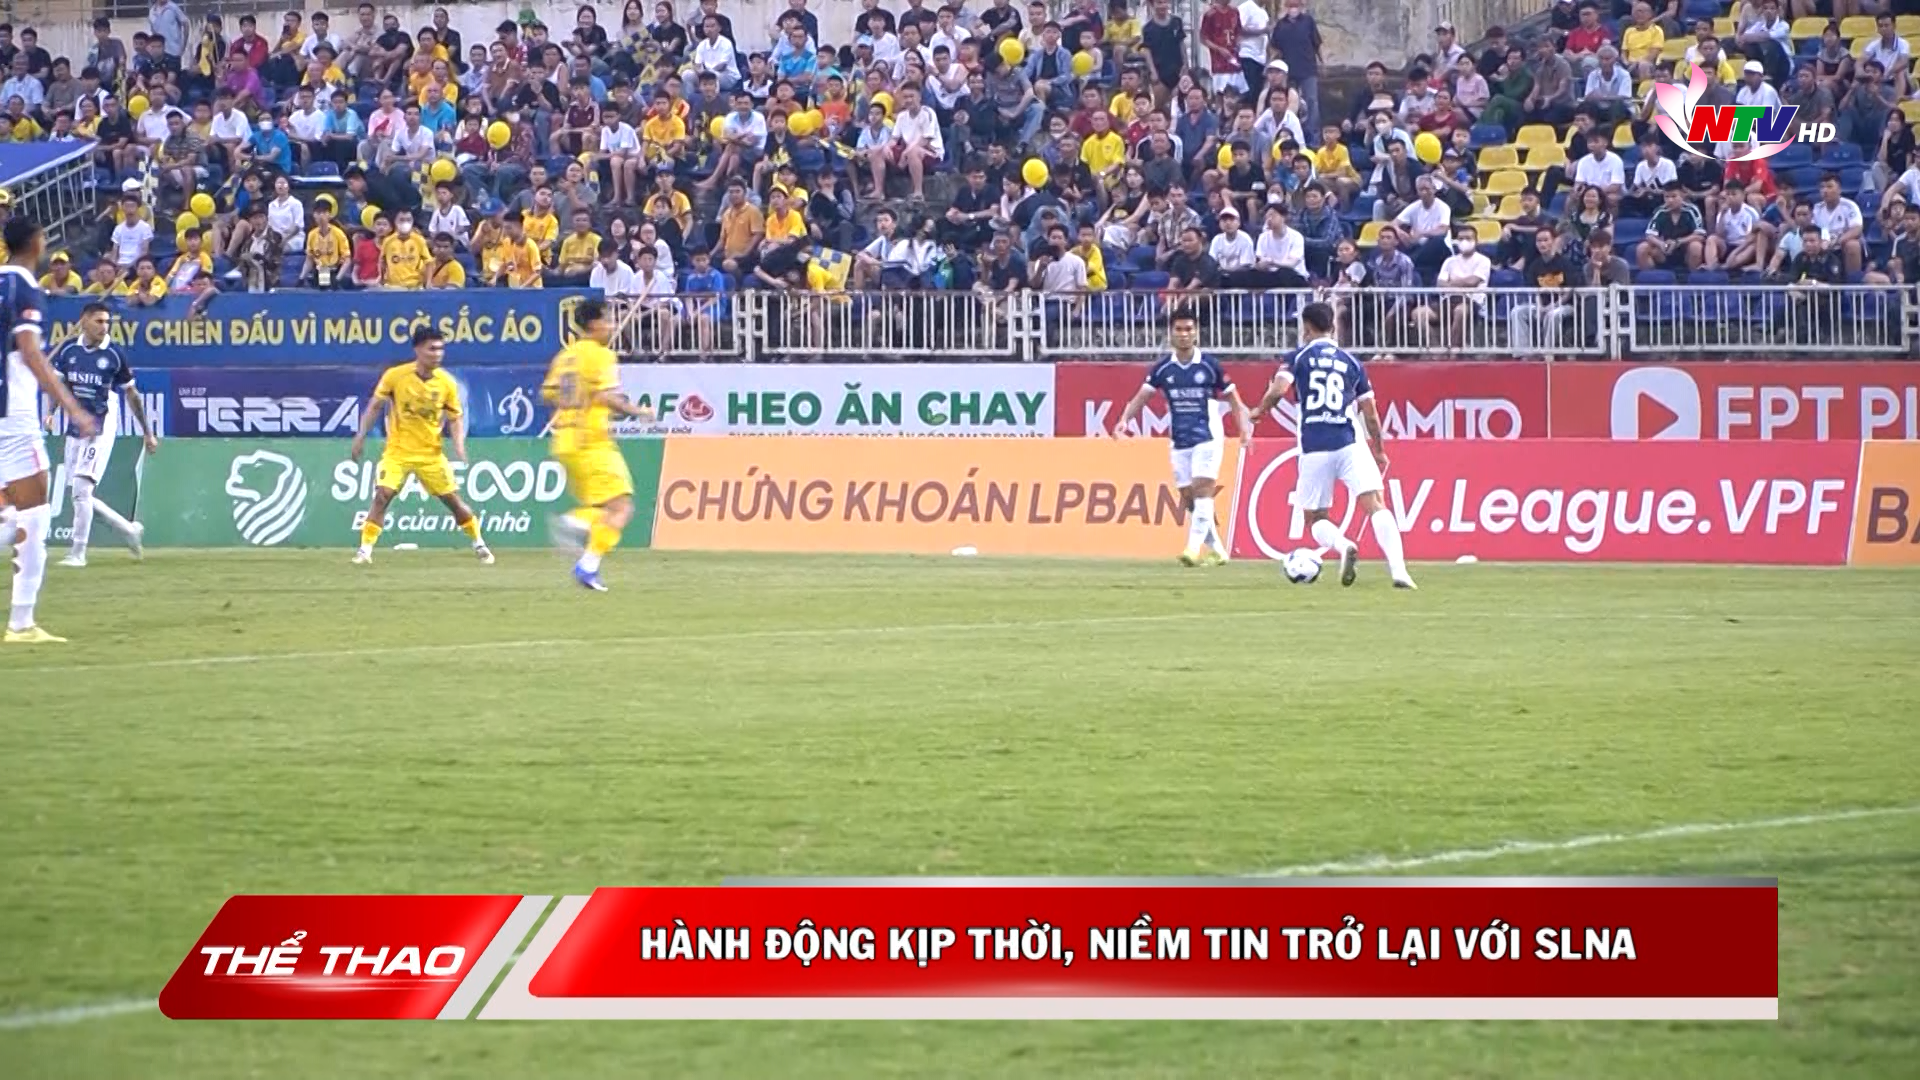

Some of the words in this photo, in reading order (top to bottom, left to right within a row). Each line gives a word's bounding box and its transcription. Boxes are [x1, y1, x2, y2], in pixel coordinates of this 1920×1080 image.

[145, 310, 223, 346] CHIẾN
[229, 308, 285, 346] ĐẤU
[290, 310, 318, 346] VÌ
[323, 310, 383, 346] MÀU
[438, 304, 495, 344] SẮC
[500, 308, 543, 343] ÁO
[727, 391, 823, 426] HEO
[835, 382, 903, 426] ĂN
[917, 391, 1047, 426] CHAY
[1379, 399, 1523, 440] AMITO
[1717, 387, 1844, 441] FPT
[83, 447, 96, 460] 19
[663, 466, 834, 522] CHỨNG
[846, 467, 1018, 525] KHOÁN
[1028, 481, 1225, 528] LPBAN
[1389, 477, 1846, 554] V.League.VPF
[398, 507, 439, 531] của
[487, 510, 532, 531] nhà
